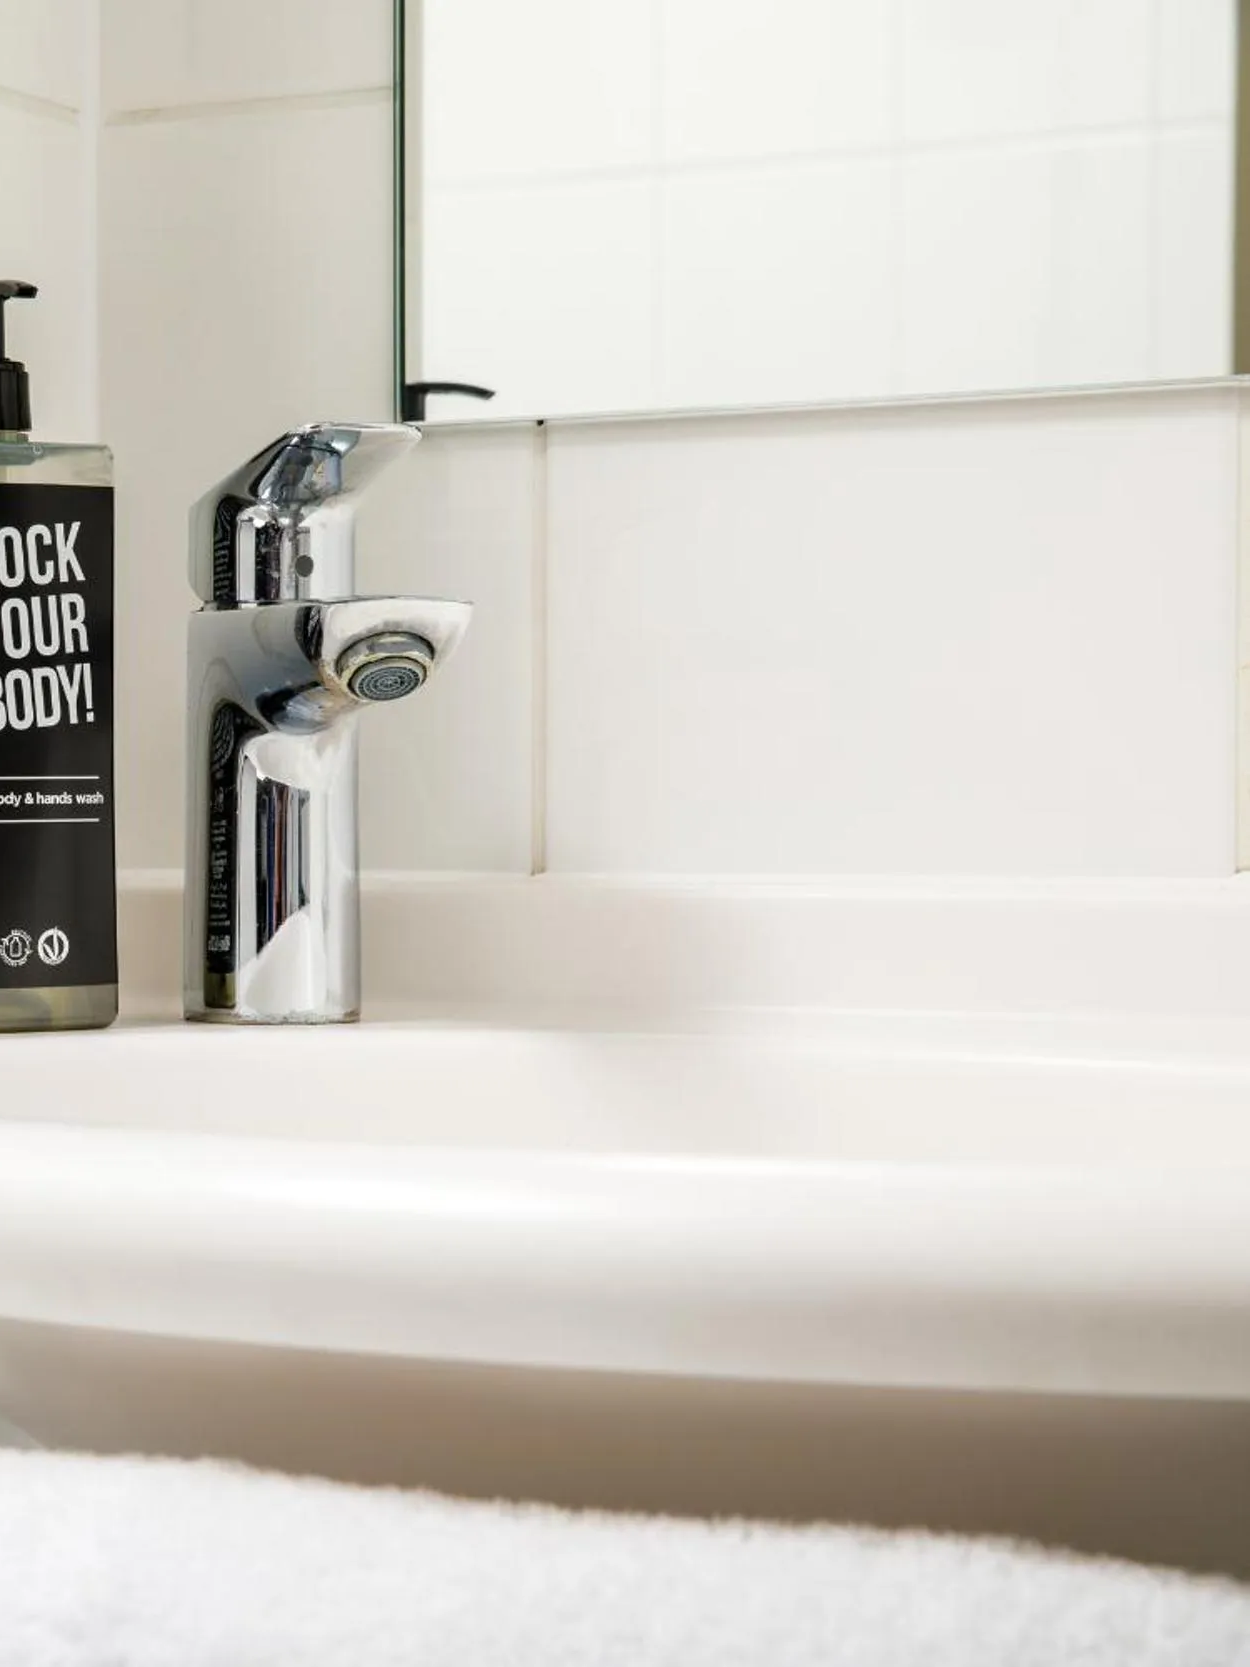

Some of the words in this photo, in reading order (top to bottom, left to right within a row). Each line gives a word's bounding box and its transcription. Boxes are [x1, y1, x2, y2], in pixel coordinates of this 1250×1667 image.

[24, 792, 35, 805] &
[35, 791, 73, 805] hands
[75, 791, 105, 805] wash
